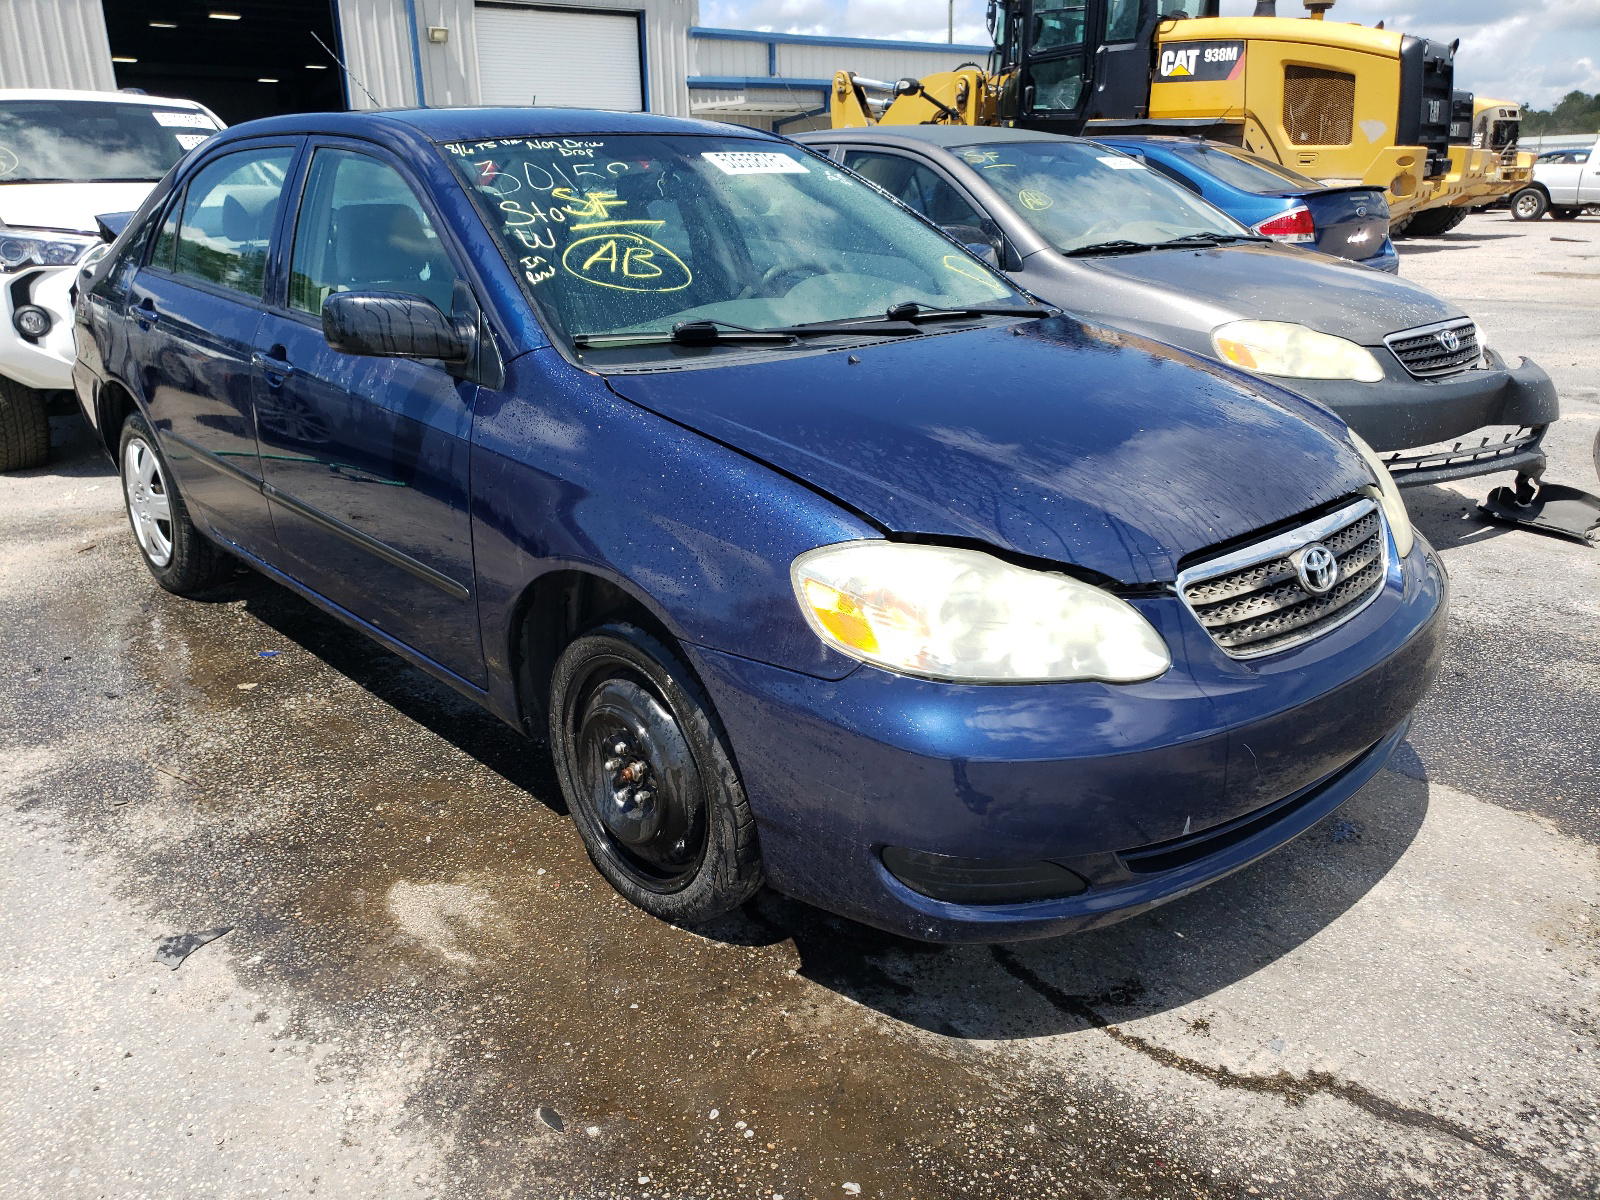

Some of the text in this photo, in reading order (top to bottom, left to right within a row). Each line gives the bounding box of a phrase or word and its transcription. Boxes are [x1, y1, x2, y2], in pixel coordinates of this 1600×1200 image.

[1161, 50, 1200, 76] CAT
[1203, 46, 1238, 62] 938M
[558, 148, 594, 157] Drop
[582, 239, 663, 278] AB
